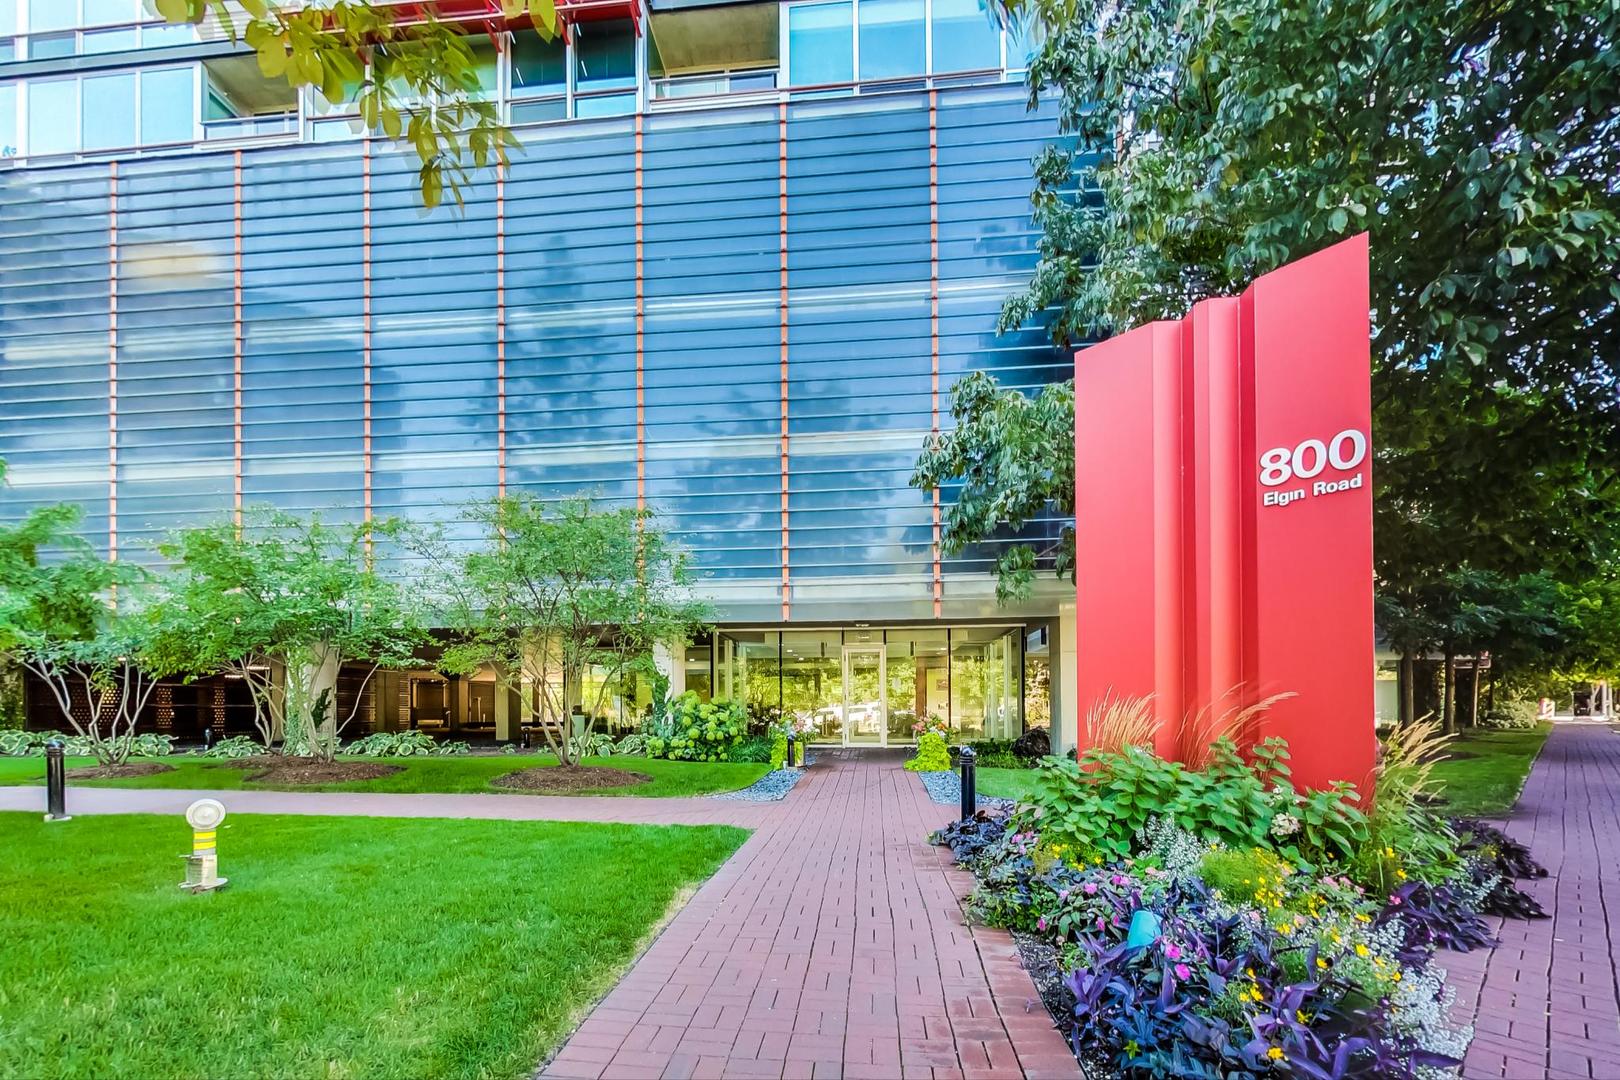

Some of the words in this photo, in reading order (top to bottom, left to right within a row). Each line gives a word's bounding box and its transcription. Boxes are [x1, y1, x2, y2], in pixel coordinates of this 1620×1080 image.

[1259, 429, 1367, 486] 800
[1263, 488, 1305, 506] Elgin
[1313, 473, 1363, 496] Road
